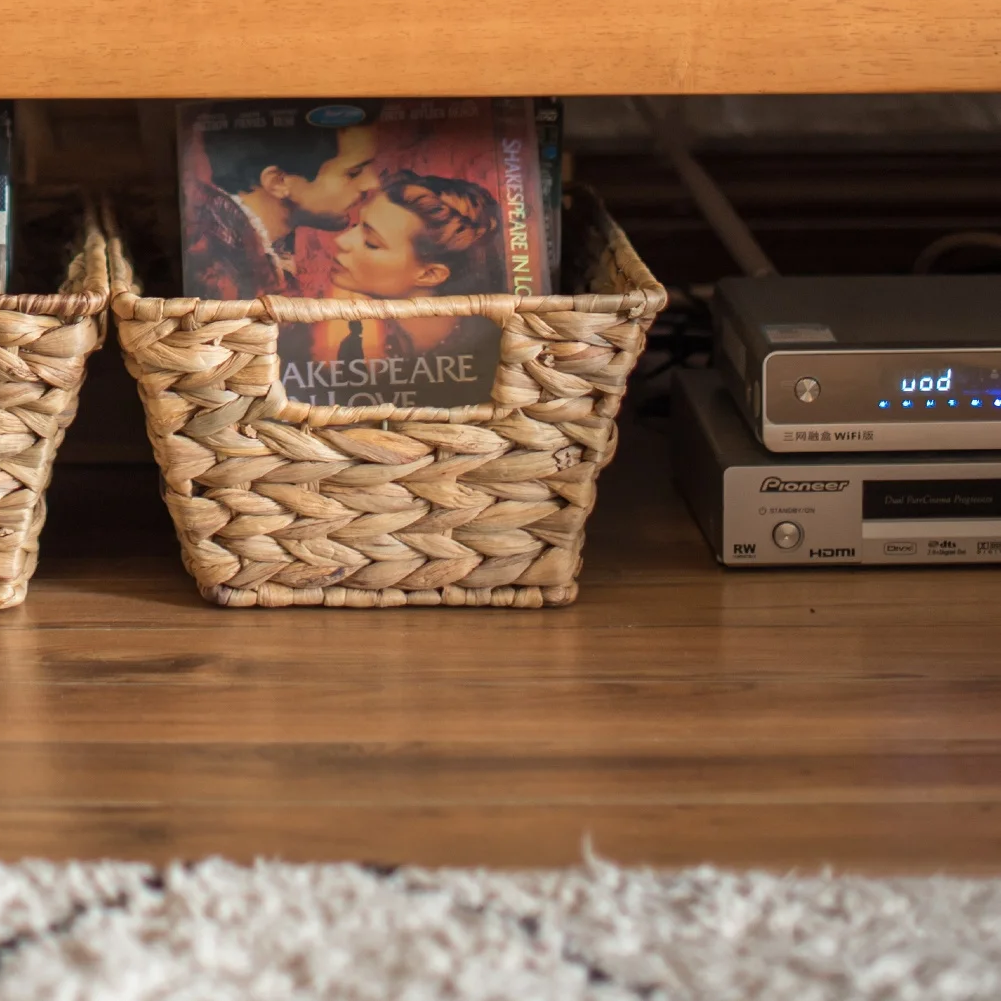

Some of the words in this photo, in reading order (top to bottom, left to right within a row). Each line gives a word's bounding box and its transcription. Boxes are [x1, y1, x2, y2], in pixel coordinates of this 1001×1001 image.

[502, 138, 529, 251] SHAKESPEARE
[511, 254, 530, 273] IN
[513, 276, 533, 296] LO
[282, 354, 478, 388] AKESPEARE
[759, 476, 850, 493] Pioneer
[733, 543, 756, 555] RW
[809, 547, 856, 558] HDMI
